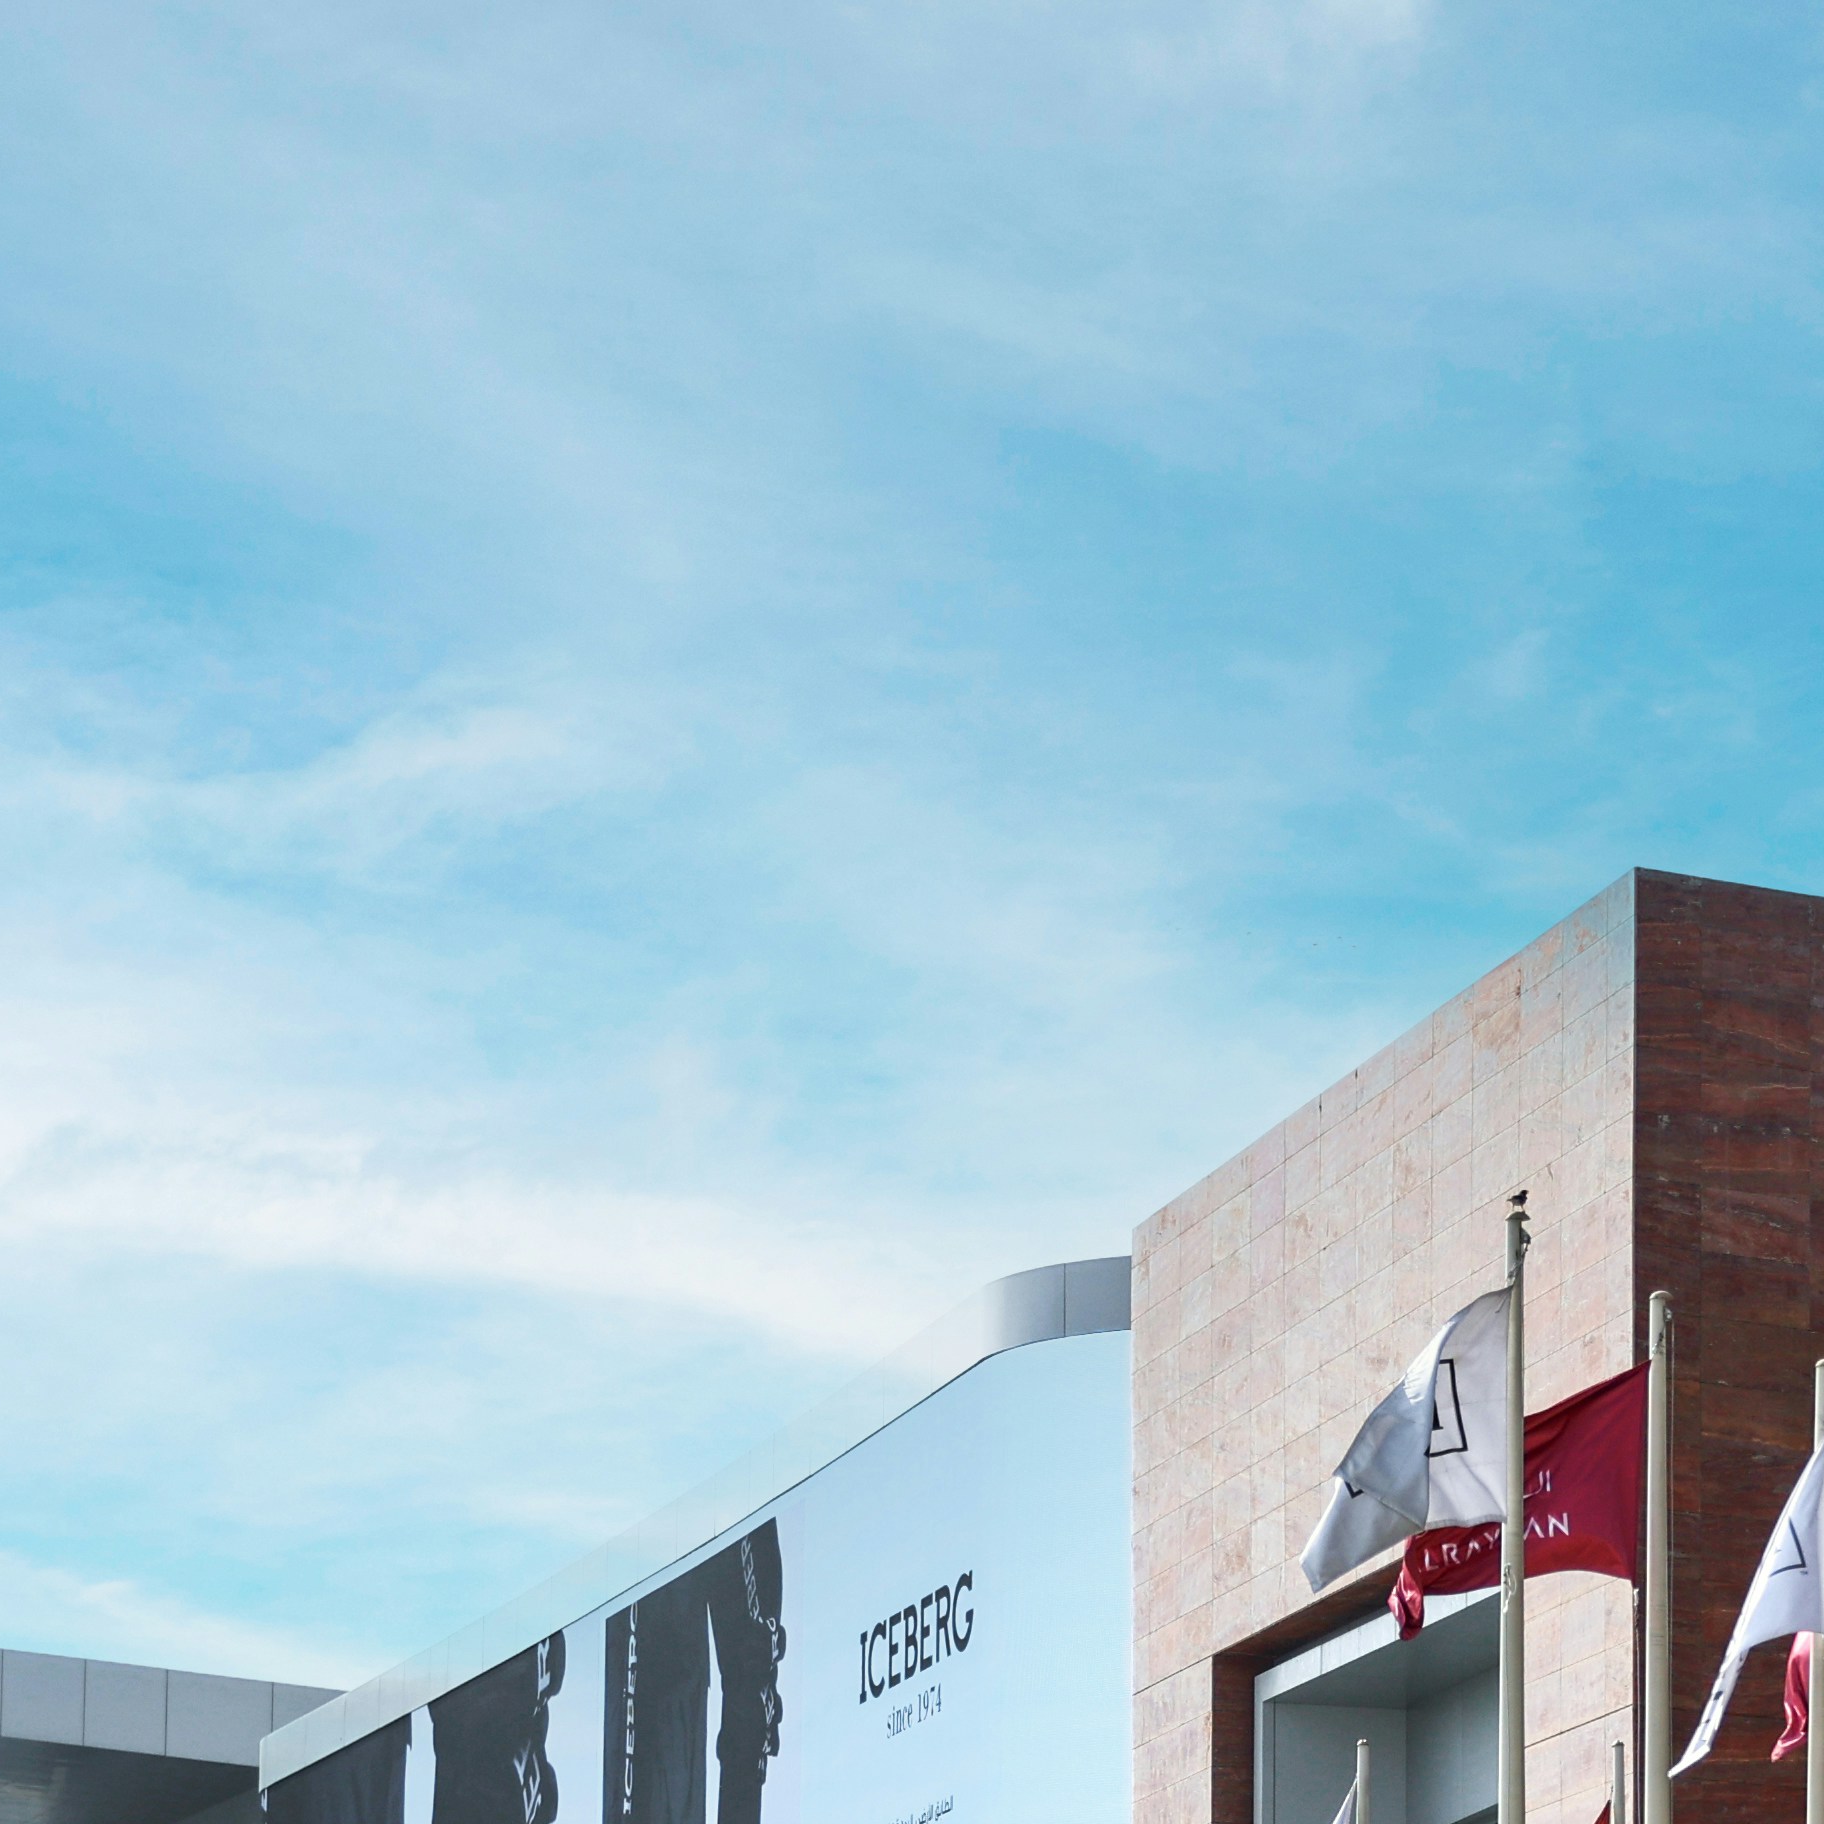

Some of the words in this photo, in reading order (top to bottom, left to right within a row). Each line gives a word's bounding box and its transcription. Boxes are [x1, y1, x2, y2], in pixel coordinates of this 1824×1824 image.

[859, 1569, 974, 1705] ICEBERG
[887, 1705, 913, 1739] since
[918, 1683, 942, 1723] 1974
